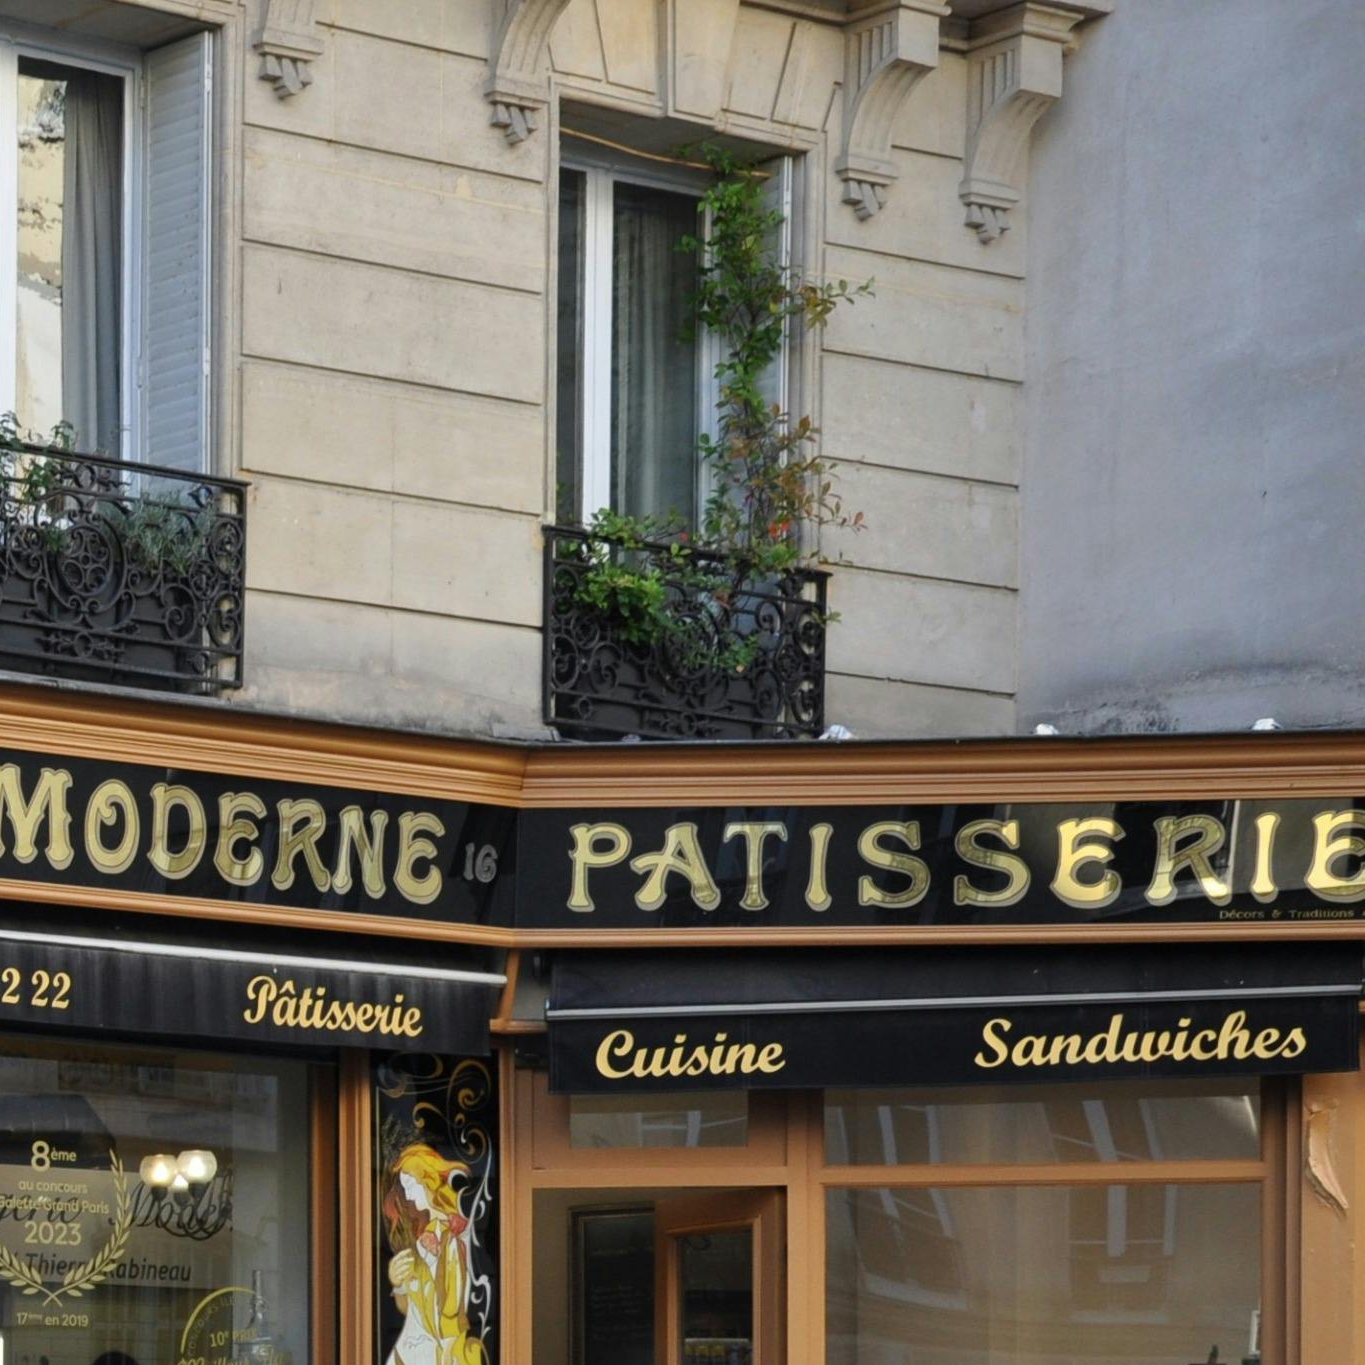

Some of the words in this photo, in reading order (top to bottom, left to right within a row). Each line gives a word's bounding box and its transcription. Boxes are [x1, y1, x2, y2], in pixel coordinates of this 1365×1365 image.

[462, 842, 498, 883] 16
[566, 808, 1365, 913] PATISSERIE
[1219, 909, 1266, 920] Décors
[1271, 909, 1281, 919] &
[1289, 908, 1355, 919] Traditions
[30, 969, 72, 1010] 22
[243, 974, 424, 1038] Pâtisserie
[594, 1029, 787, 1080] Cuisine
[974, 1009, 1308, 1070] Sandwiches
[31, 1139, 77, 1173] 8ème
[18, 1181, 35, 1192] au
[35, 1181, 89, 1195] concours
[44, 1199, 80, 1213] Grand
[81, 1200, 110, 1215] Paris
[24, 1220, 83, 1246] 2023
[25, 1252, 88, 1276] Thierr
[45, 1315, 60, 1326] en
[62, 1313, 89, 1328] 2019
